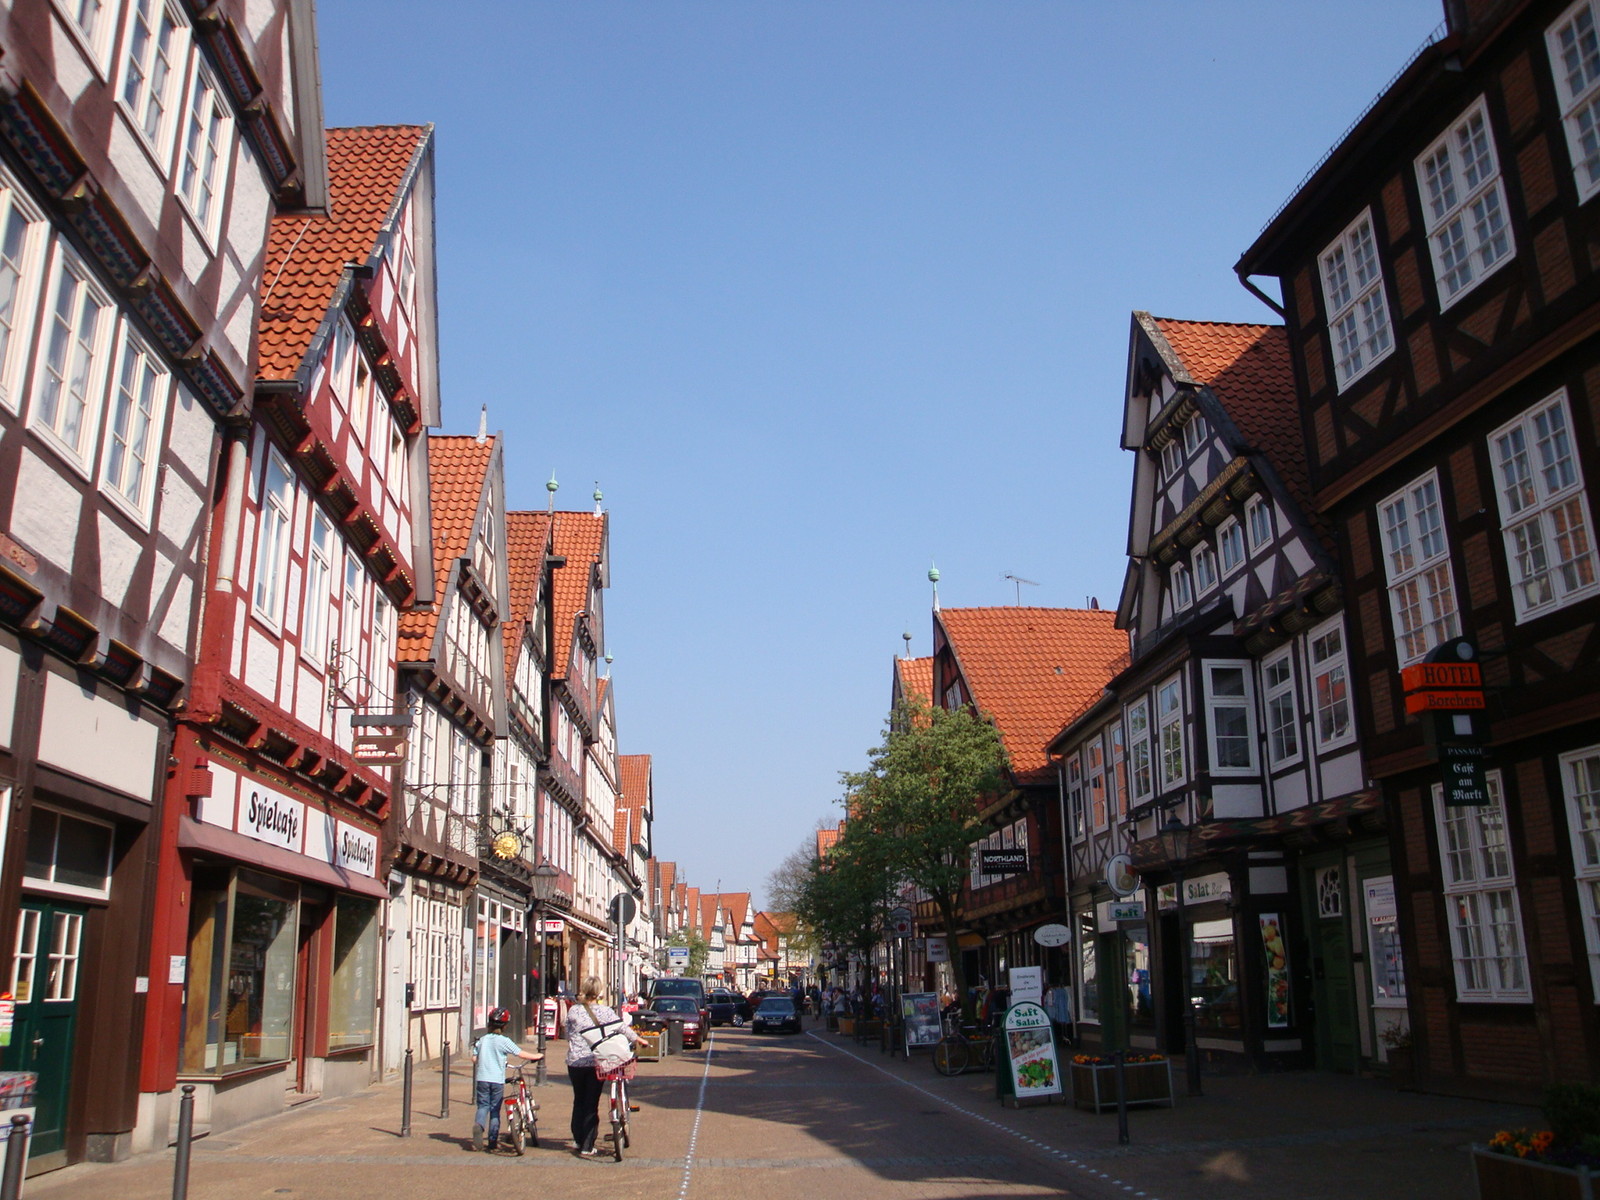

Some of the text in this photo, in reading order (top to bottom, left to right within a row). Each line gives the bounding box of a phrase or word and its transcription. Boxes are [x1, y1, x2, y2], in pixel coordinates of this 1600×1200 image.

[1424, 666, 1477, 684] HOTEL
[1427, 694, 1482, 707] Borchers
[1453, 763, 1474, 775] Café
[1459, 778, 1473, 786] am
[1452, 790, 1482, 800] Markt
[1188, 883, 1209, 899] Salat
[1115, 909, 1138, 918] Saft
[1014, 1008, 1038, 1017] Saft
